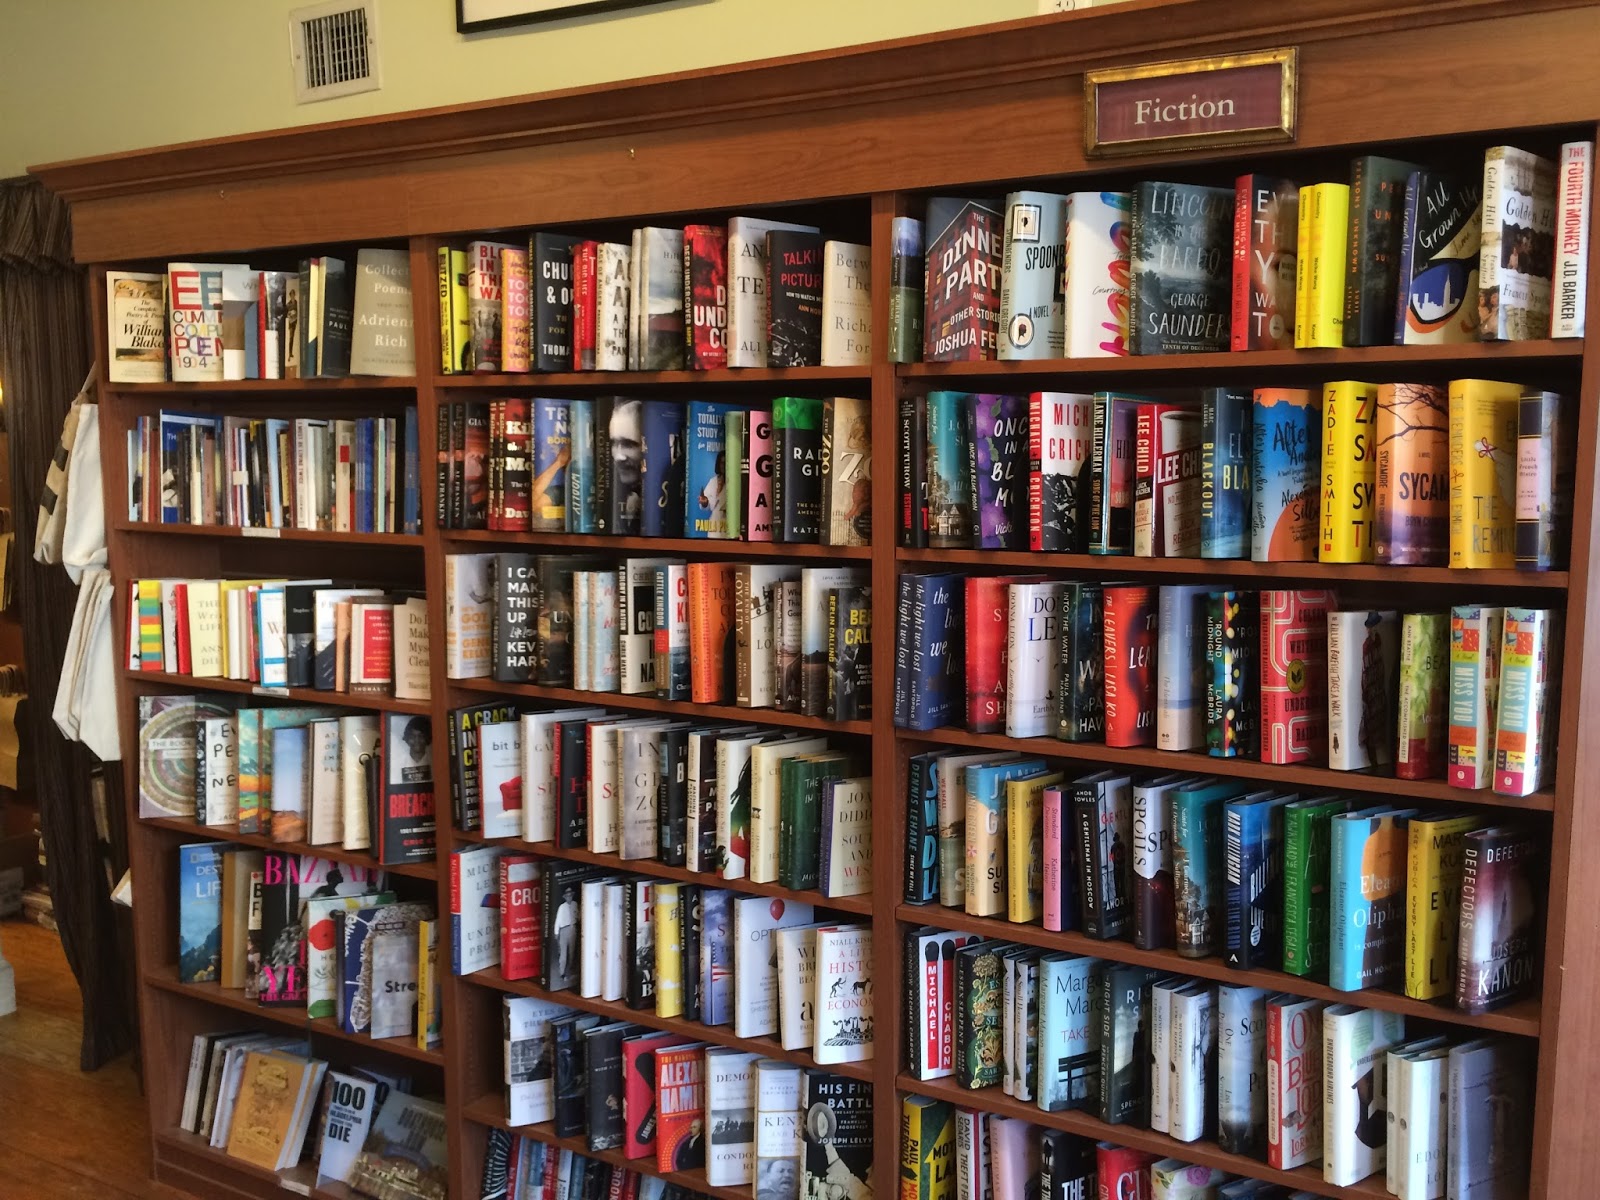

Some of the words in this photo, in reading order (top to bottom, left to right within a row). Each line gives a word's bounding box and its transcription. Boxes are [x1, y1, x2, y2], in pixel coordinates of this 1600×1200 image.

[1134, 94, 1236, 126] Fiction
[1568, 146, 1586, 158] THE
[1486, 166, 1498, 200] Golden
[1566, 161, 1585, 206] FOURTH
[1426, 181, 1449, 219] All
[1485, 203, 1497, 227] Hill
[1506, 196, 1537, 222] Golden
[973, 212, 985, 223] THE
[1418, 206, 1461, 250] Grown
[1563, 206, 1583, 256] MONKEY
[480, 259, 494, 271] IN
[942, 226, 1003, 275] DINNE
[1003, 228, 1012, 274] SPOONBENDERS
[1160, 243, 1222, 276] BARDO
[1562, 260, 1578, 280] J.D.
[973, 292, 985, 301] AND
[1002, 289, 1010, 311] DARYL
[1170, 292, 1210, 309] GEORGE
[1502, 282, 1530, 301] Francis
[1560, 281, 1577, 320] BARKER
[329, 321, 347, 331] PAUL
[950, 305, 975, 327] OTHER
[976, 305, 1001, 323] STORIE
[1001, 310, 1010, 335] GREGORY
[375, 334, 408, 348] Rich
[934, 327, 977, 355] JOSHUA
[697, 413, 725, 426] TOTALLY
[1029, 401, 1041, 455] MICHAEL
[1094, 402, 1105, 427] ANNE
[1137, 414, 1150, 435] LEE
[1327, 390, 1338, 457] ZADIE
[507, 441, 522, 451] the
[697, 426, 718, 439] STUDY
[821, 434, 832, 475] ZOO
[1092, 427, 1104, 474] HILLERMAN
[1136, 436, 1150, 474] CHILD
[902, 451, 911, 489] TUROW
[1156, 454, 1180, 485] LEE
[1201, 442, 1214, 519] BLACKOUT
[1379, 450, 1390, 489] SYCAMORE
[570, 472, 581, 516] WOOLLY
[1029, 477, 1041, 532] CRICHTON
[1323, 474, 1336, 541] SMITH
[695, 518, 717, 532] PAULA
[903, 492, 911, 530] TESTIMONY
[792, 526, 818, 534] KATE
[656, 571, 665, 595] CATTLE
[902, 581, 911, 597] the
[916, 583, 925, 600] the
[932, 586, 950, 605] the
[507, 597, 539, 608] THIS
[656, 596, 665, 626] KINGDOM
[735, 571, 744, 635] LOYALTY
[828, 594, 837, 626] BERLIN
[898, 598, 912, 628] light
[913, 601, 926, 630] light
[1062, 591, 1070, 613] INTO
[409, 613, 422, 625] Do
[506, 612, 527, 623] UP
[827, 627, 836, 663] CALLING
[899, 629, 908, 645] we
[913, 631, 922, 648] we
[930, 639, 948, 657] we
[1061, 635, 1069, 665] WATER
[1104, 610, 1116, 661] LEAVERS
[1215, 620, 1223, 658] 'ROUND
[898, 645, 910, 669] lost
[913, 649, 925, 672] lost
[1105, 671, 1116, 699] LISA
[1454, 666, 1475, 697] MISS
[1505, 670, 1528, 701] MISS
[461, 713, 471, 730] A
[474, 706, 516, 725] CRACK
[1105, 701, 1117, 718] KO
[1207, 683, 1215, 725] McBRIDE
[1215, 689, 1223, 721] LAURA
[1453, 700, 1473, 722] YOU
[1503, 705, 1524, 728] YOU
[151, 740, 168, 748] THE
[172, 739, 193, 747] BOOK
[492, 741, 509, 751] bit
[804, 776, 819, 790] THE
[910, 763, 920, 806] DENNIS
[908, 808, 919, 853] LEHANE
[1051, 807, 1059, 841] Standard
[1134, 795, 1147, 867] SPOILS
[1412, 827, 1420, 850] MARY
[1082, 821, 1091, 863] GENTLEMAN
[1085, 864, 1092, 873] IN
[1411, 853, 1419, 889] KUBICA
[499, 861, 508, 914] CROOKED
[1086, 875, 1094, 910] MOSCOW
[1285, 876, 1298, 923] FRANCESCA
[1410, 895, 1418, 927] EVERY
[829, 937, 853, 946] NIALL
[838, 950, 845, 958] A
[1490, 936, 1528, 961] JOSEPH
[906, 941, 914, 985] MOONGLOW
[1356, 967, 1372, 980] GAIL
[1477, 956, 1535, 997] KANON
[927, 965, 937, 1041] MICHAEL
[1039, 977, 1049, 1017] Margaret
[1103, 981, 1111, 1015] RIGHT
[943, 1001, 951, 1066] CHABON
[1039, 1018, 1047, 1048] Maron
[1060, 1026, 1090, 1043] TAKE
[1326, 1037, 1334, 1079] UNDERGROUND
[331, 1080, 367, 1111] 100
[818, 1083, 842, 1095] HIS
[848, 1083, 873, 1095] FIN
[827, 1097, 873, 1109] BATTL
[1326, 1080, 1334, 1105] AIRLINES
[328, 1121, 352, 1144] DIE
[901, 1114, 910, 1165] THEROUX
[963, 1117, 971, 1151] DAVID
[909, 1138, 919, 1166] PAUL
[960, 1153, 969, 1183] THEFT
